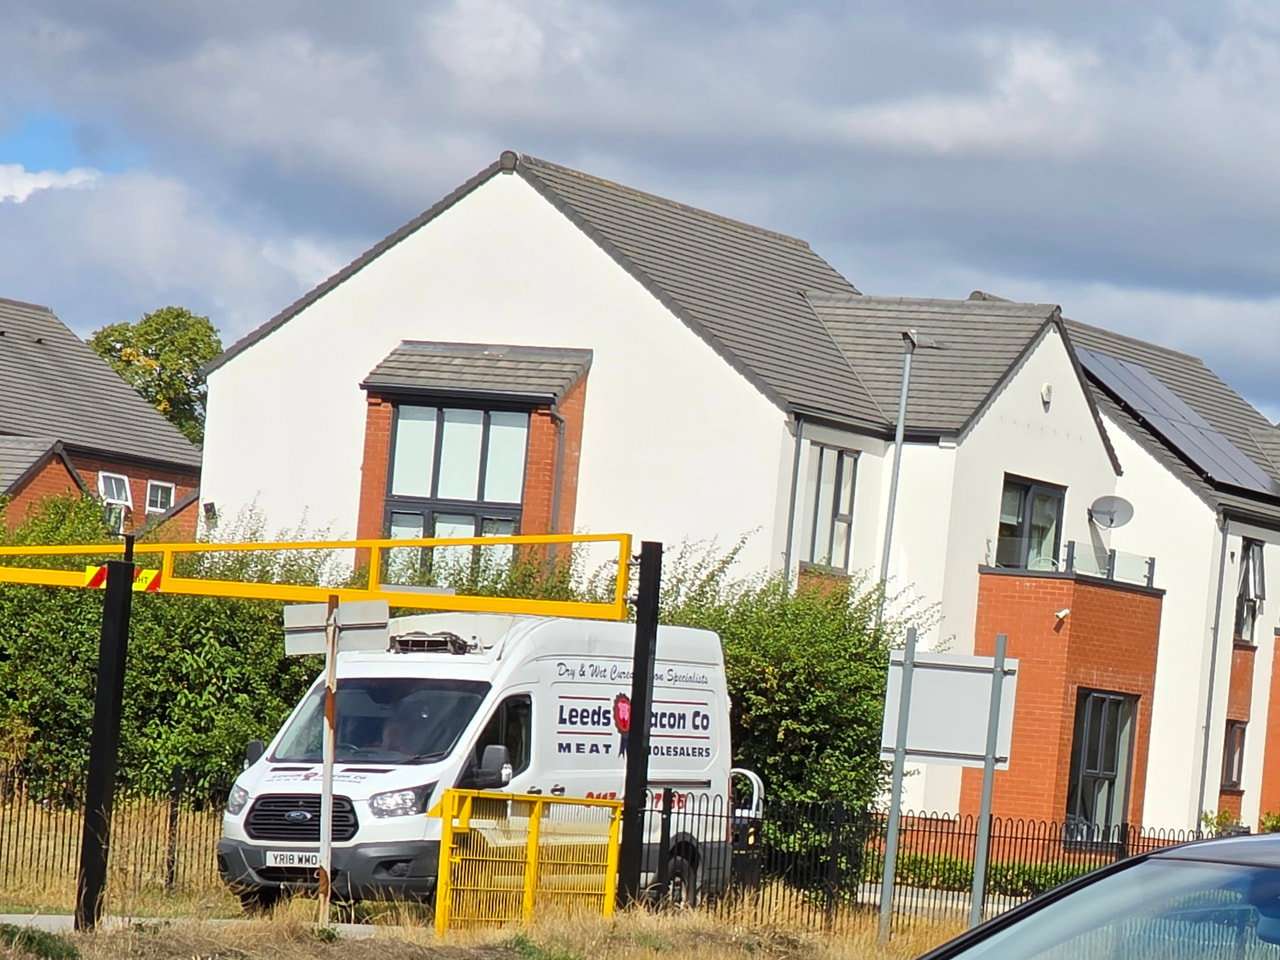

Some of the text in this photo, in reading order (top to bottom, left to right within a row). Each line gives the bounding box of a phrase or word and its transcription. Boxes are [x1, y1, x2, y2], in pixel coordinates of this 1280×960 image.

[557, 662, 575, 680] Dry
[579, 663, 586, 677] &
[589, 664, 607, 678] Wet
[558, 705, 710, 731] Leeds acon Co
[557, 742, 612, 754] MEAT
